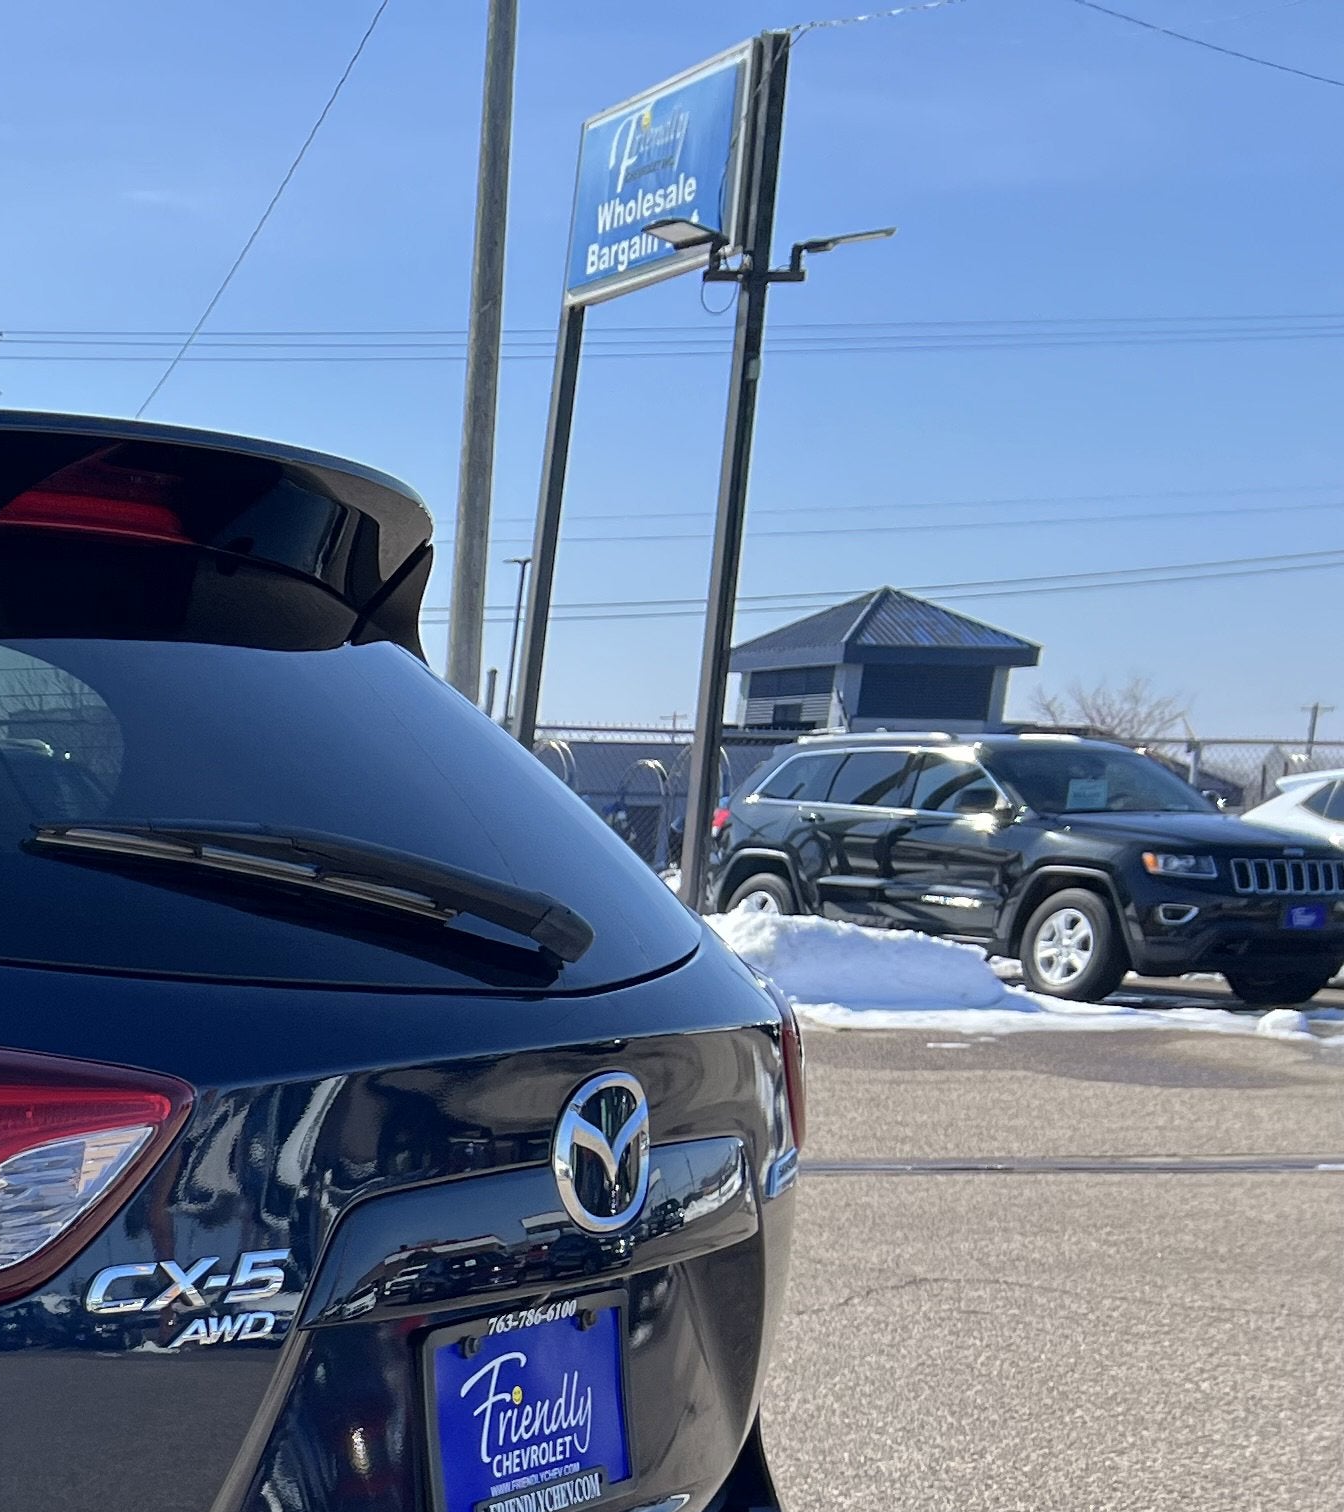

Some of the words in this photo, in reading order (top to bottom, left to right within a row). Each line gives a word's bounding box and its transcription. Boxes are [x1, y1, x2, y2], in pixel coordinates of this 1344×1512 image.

[596, 174, 698, 235] Wholesale
[85, 1247, 292, 1314] CX-5
[167, 1310, 276, 1349] AWD
[486, 1299, 578, 1336] 763-786-6100
[460, 1351, 592, 1464] Friendly
[492, 1435, 572, 1478] CHEVROLET
[490, 1461, 581, 1498] WWW.FRIENDLYCHEV.COM
